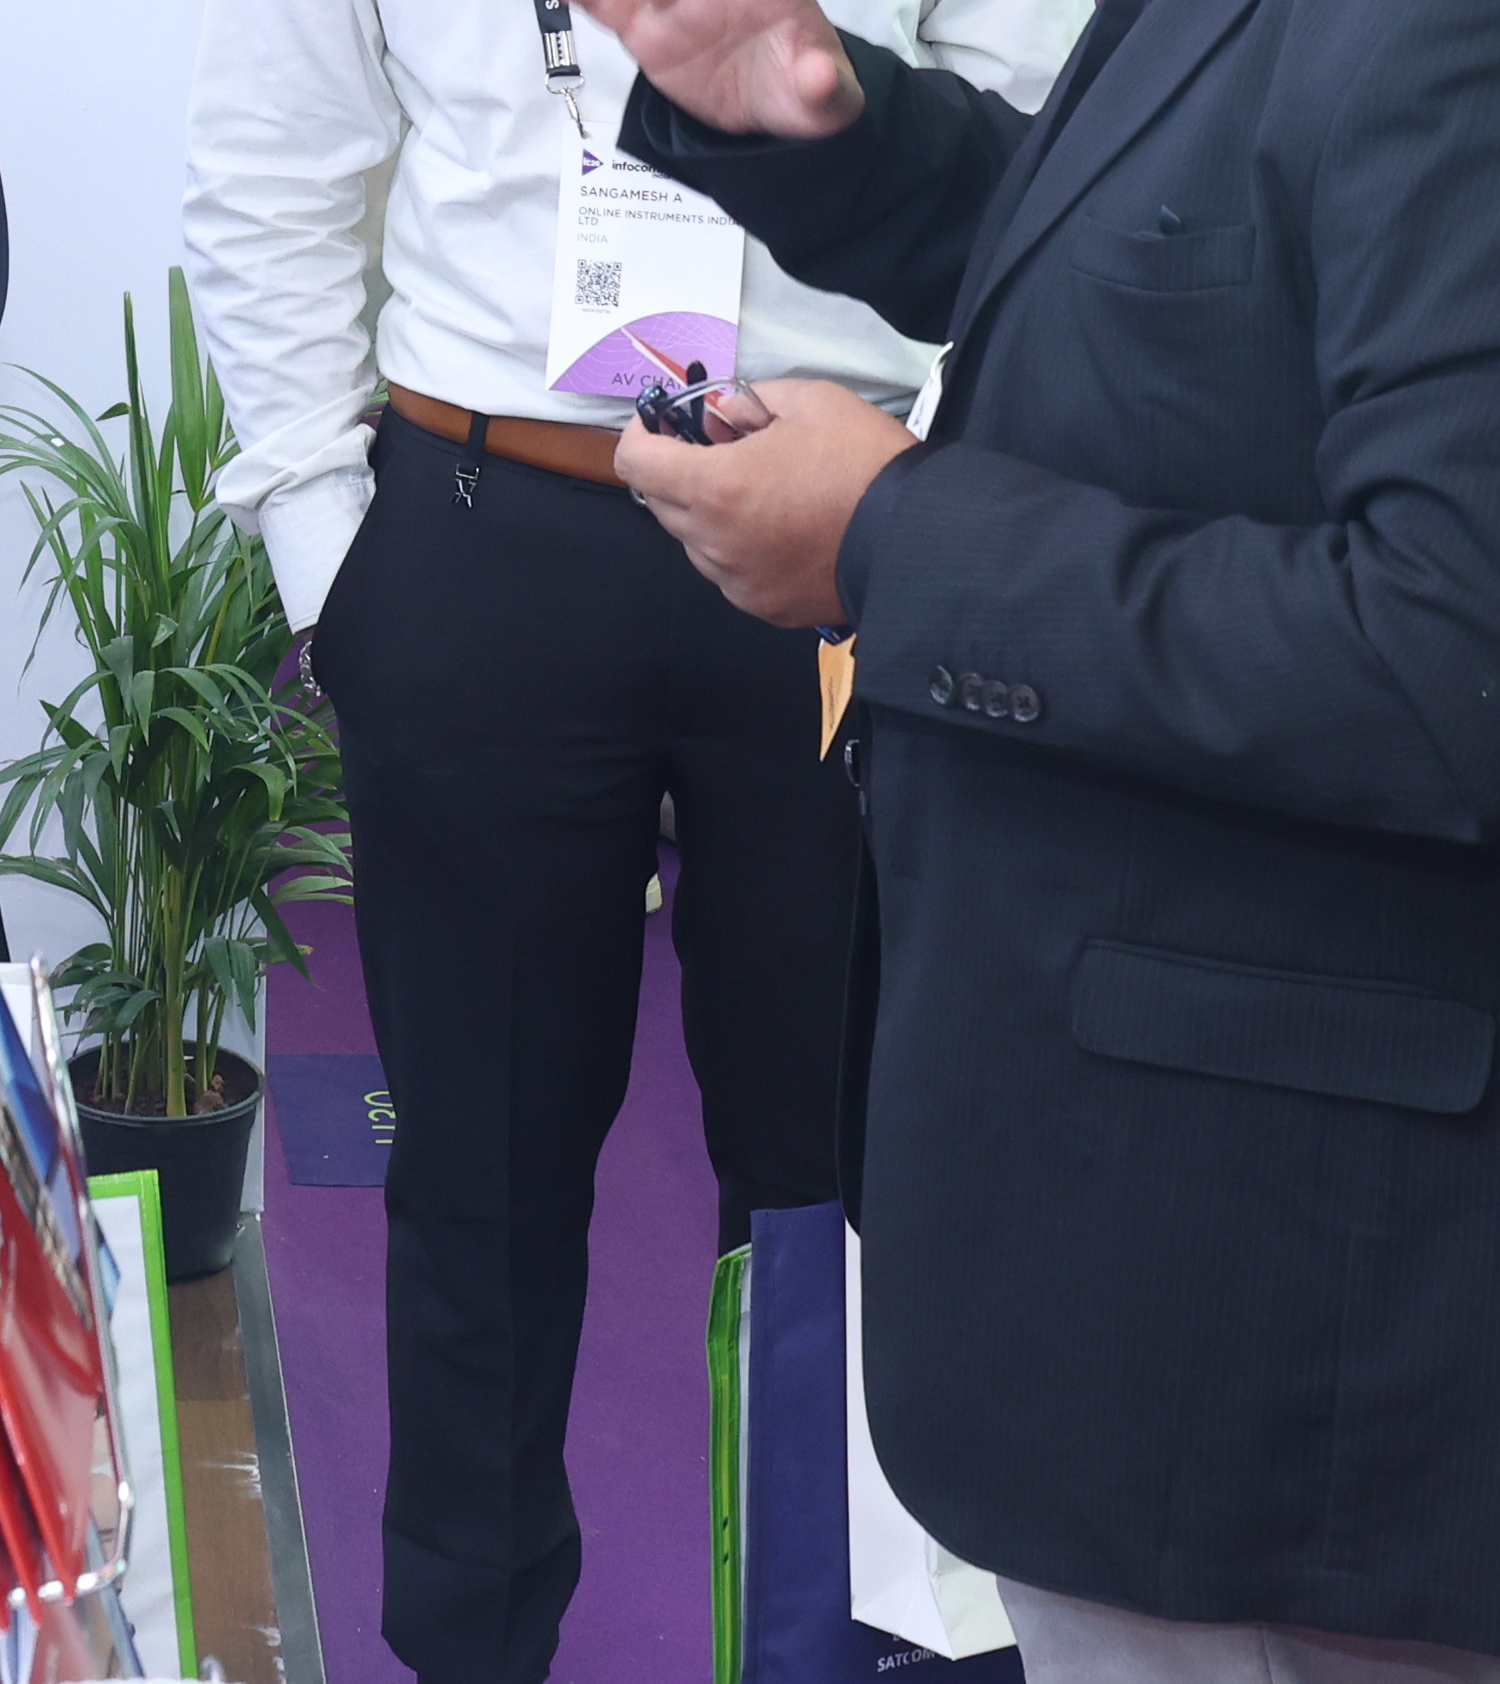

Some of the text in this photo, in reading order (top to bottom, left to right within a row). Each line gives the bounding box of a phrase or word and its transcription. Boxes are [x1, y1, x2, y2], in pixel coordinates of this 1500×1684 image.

[580, 185, 683, 203] SANGAMESH A
[578, 206, 622, 219] ONLINE
[625, 209, 704, 224] INSTRUMENTS
[578, 217, 599, 226] LTD
[577, 232, 608, 244] INDIA
[611, 371, 635, 387] AV
